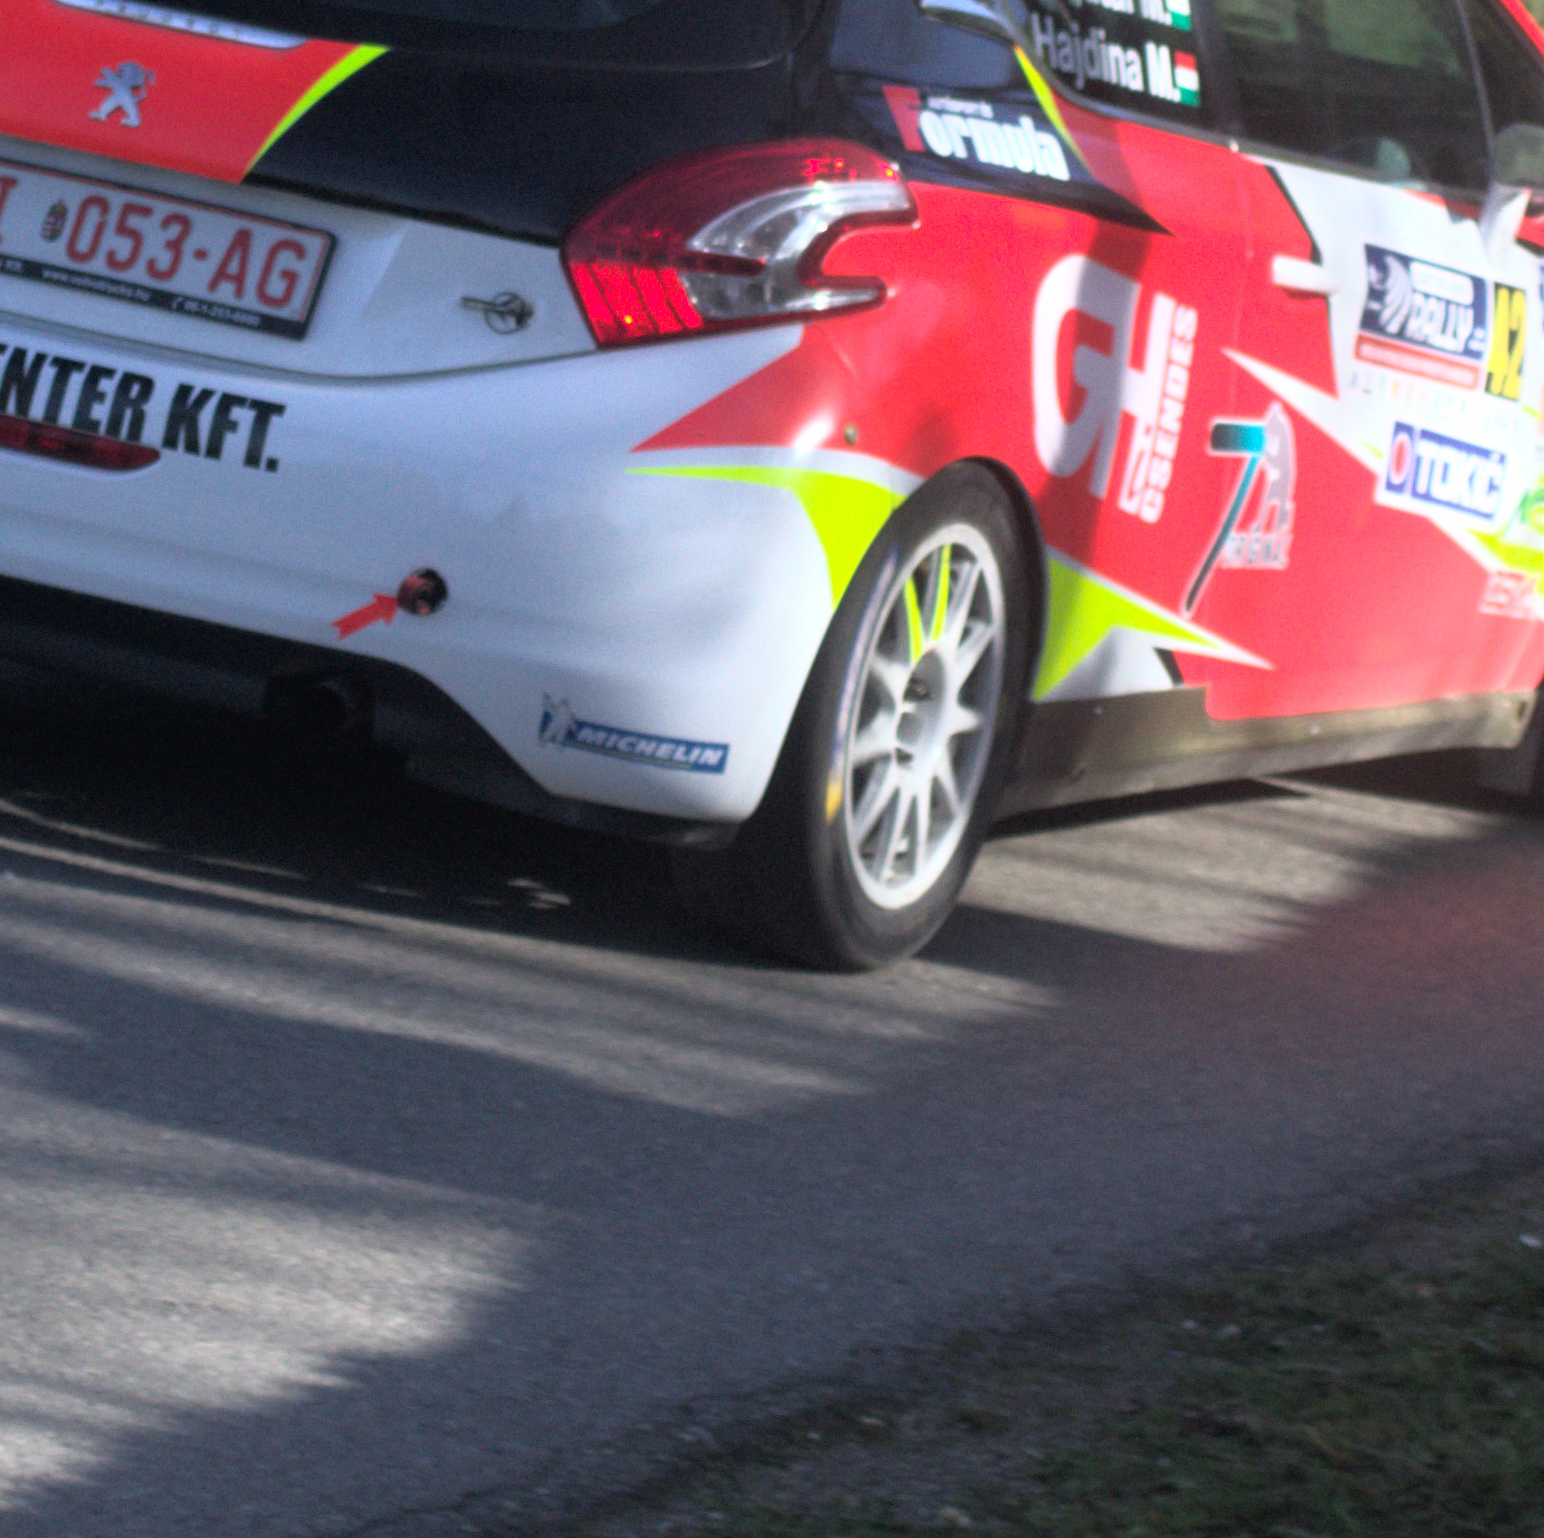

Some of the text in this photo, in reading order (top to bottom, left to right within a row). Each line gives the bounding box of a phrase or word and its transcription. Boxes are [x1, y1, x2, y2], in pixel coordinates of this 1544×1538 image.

[1031, 12, 1182, 103] Hajdina M.
[1406, 292, 1475, 354] RALLY
[1486, 286, 1527, 400] 42
[160, 382, 287, 473] KFT.
[576, 727, 725, 766] MICHELIN
